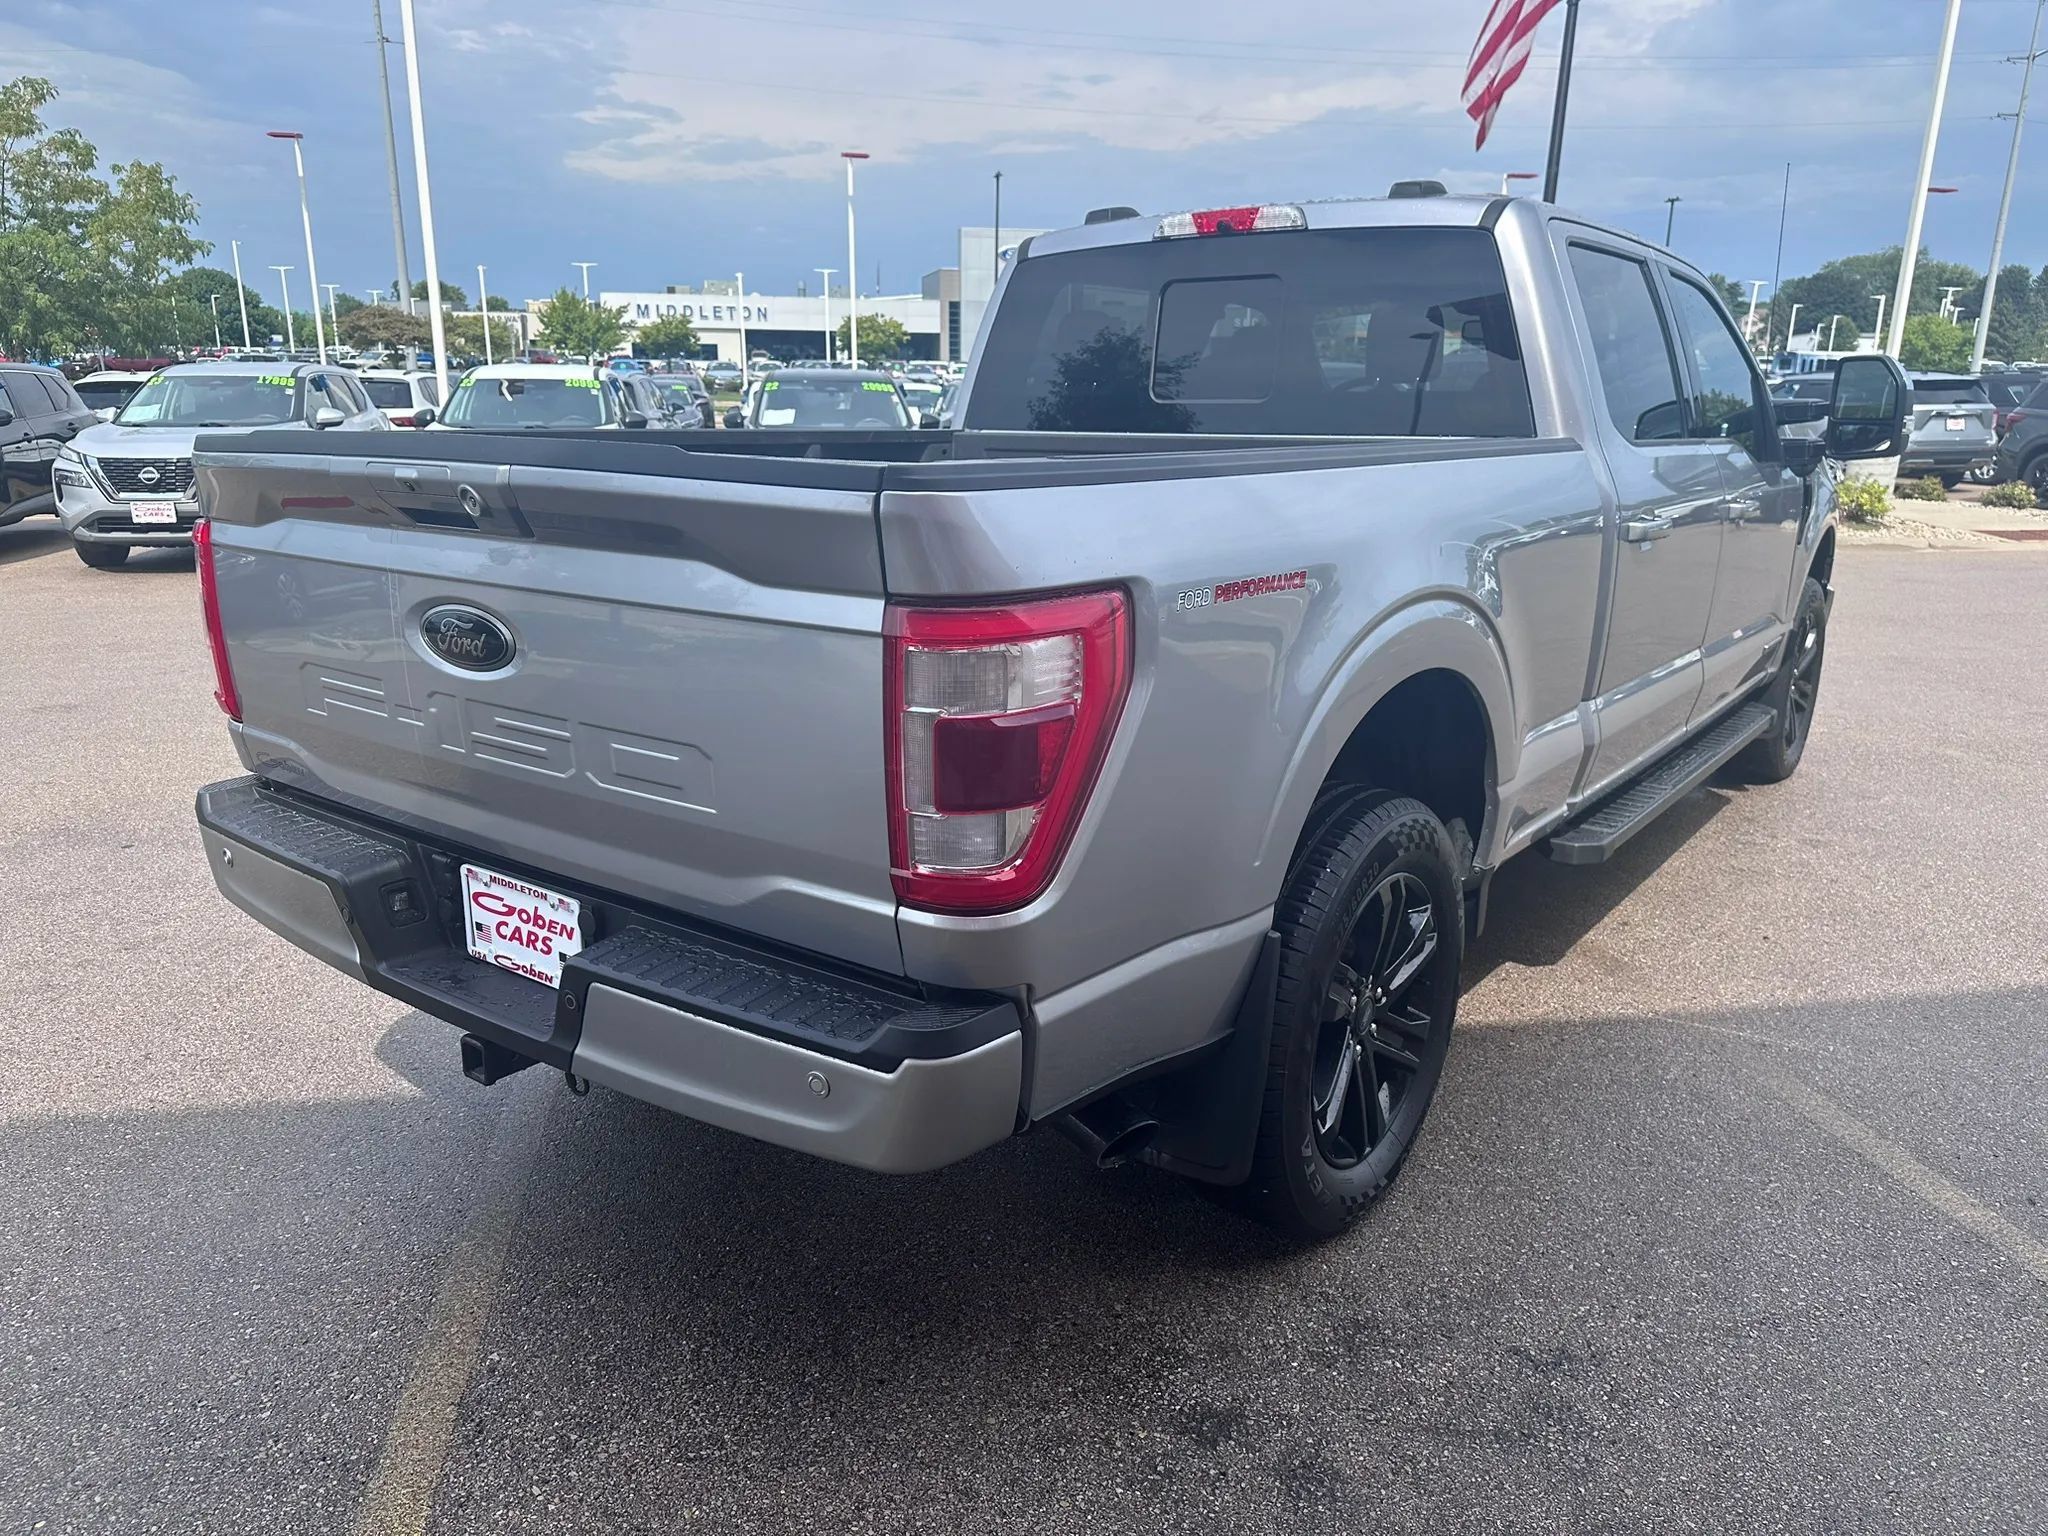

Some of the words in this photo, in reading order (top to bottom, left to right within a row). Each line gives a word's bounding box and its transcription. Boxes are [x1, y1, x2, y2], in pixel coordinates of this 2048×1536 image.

[636, 303, 768, 322] MIDDLETON
[1177, 586, 1212, 612] FORD
[1214, 570, 1307, 604] PERFORMANCE
[437, 617, 487, 657] Ford
[300, 661, 718, 814] F-150
[489, 874, 548, 901] MIDDLETON
[471, 949, 488, 961] USA
[495, 920, 553, 956] CARS
